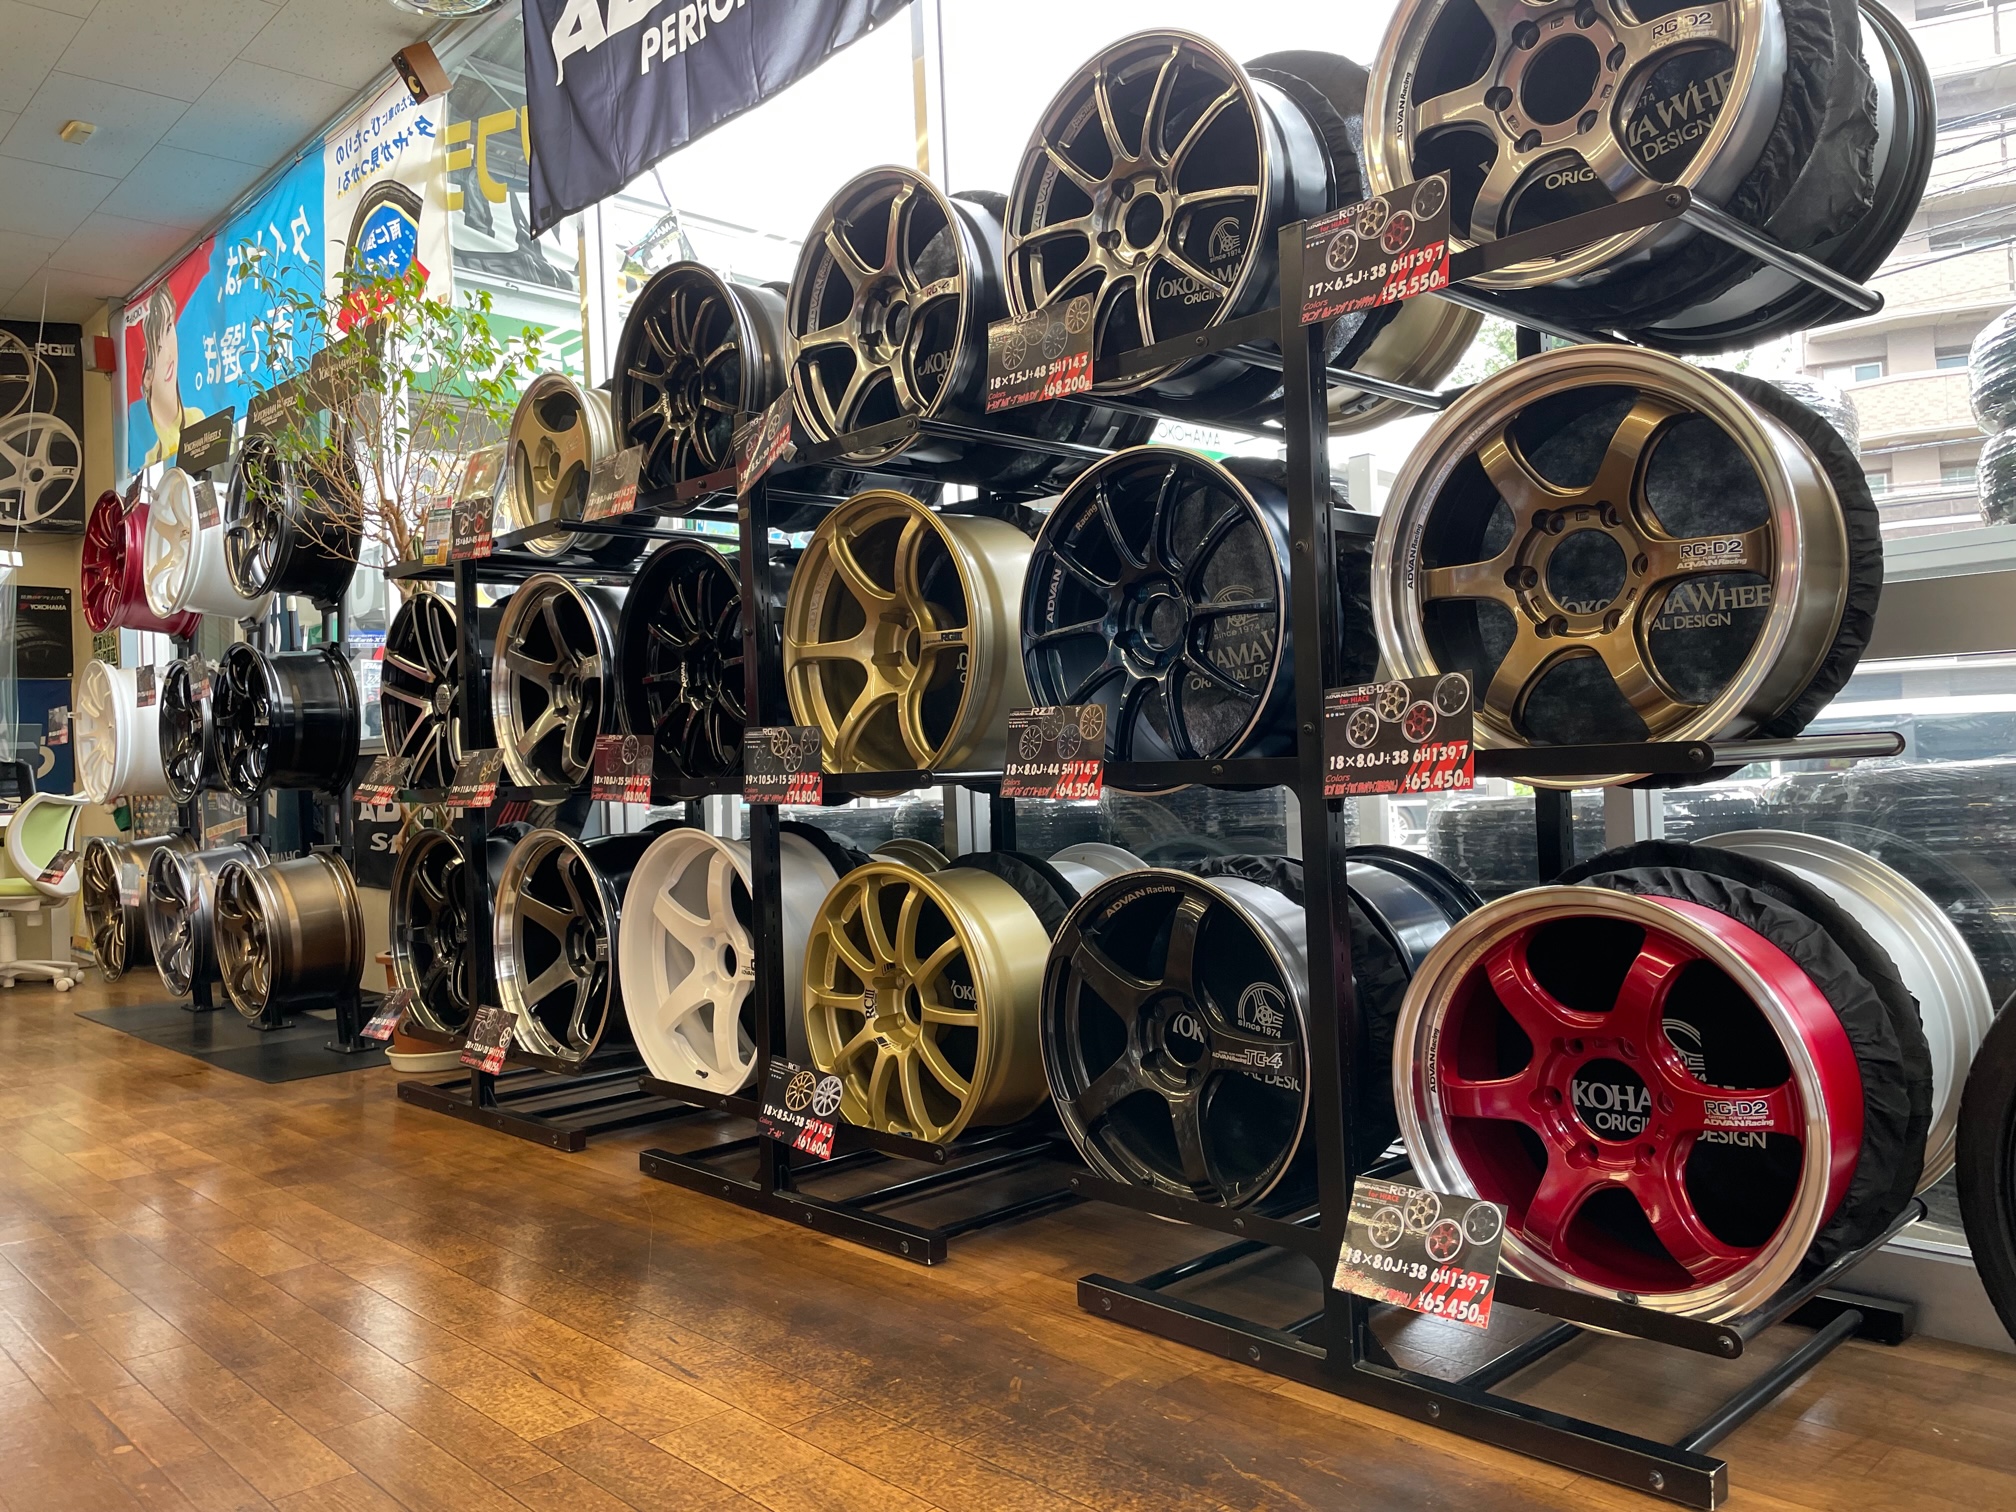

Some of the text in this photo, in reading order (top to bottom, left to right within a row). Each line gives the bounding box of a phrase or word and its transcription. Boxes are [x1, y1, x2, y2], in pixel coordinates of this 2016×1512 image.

[641, 0, 747, 75] PERFO
[1397, 99, 1405, 141] ADVAN
[1643, 113, 1715, 161] DESIGN
[1545, 167, 1598, 190] ORIG
[1308, 245, 1446, 298] 17×6.5J+38 6H139.7
[1302, 299, 1329, 311] Colors
[990, 355, 1088, 390] 18×7.5J+48 5H114.3
[1075, 503, 1098, 531] Racing
[1407, 549, 1417, 589] ADVAN
[1412, 523, 1423, 549] Racing
[1680, 539, 1743, 559] RG-D2
[1676, 558, 1748, 570] ADVAN Racing
[1046, 568, 1062, 623] ADVAN
[1652, 613, 1731, 632] AL DESIGN
[1358, 684, 1392, 696] RG-D2
[1330, 744, 1468, 770] 18×8.0J+38 6H139.7
[1006, 763, 1099, 776] 18×8.0J+44 5H114.3
[1325, 774, 1351, 783] Colors
[1105, 884, 1176, 918] ADVAN Racing
[1237, 1018, 1282, 1039] since 1974
[1430, 1028, 1440, 1053] Racing
[1244, 1049, 1283, 1069] TC-4
[1704, 1100, 1769, 1116] RG-D2
[1703, 1118, 1745, 1126] ADVAN
[1389, 1185, 1424, 1200] RG-D2
[1345, 1248, 1428, 1280] 18×8.0J+38
[1430, 1269, 1490, 1295] 6H139.7
